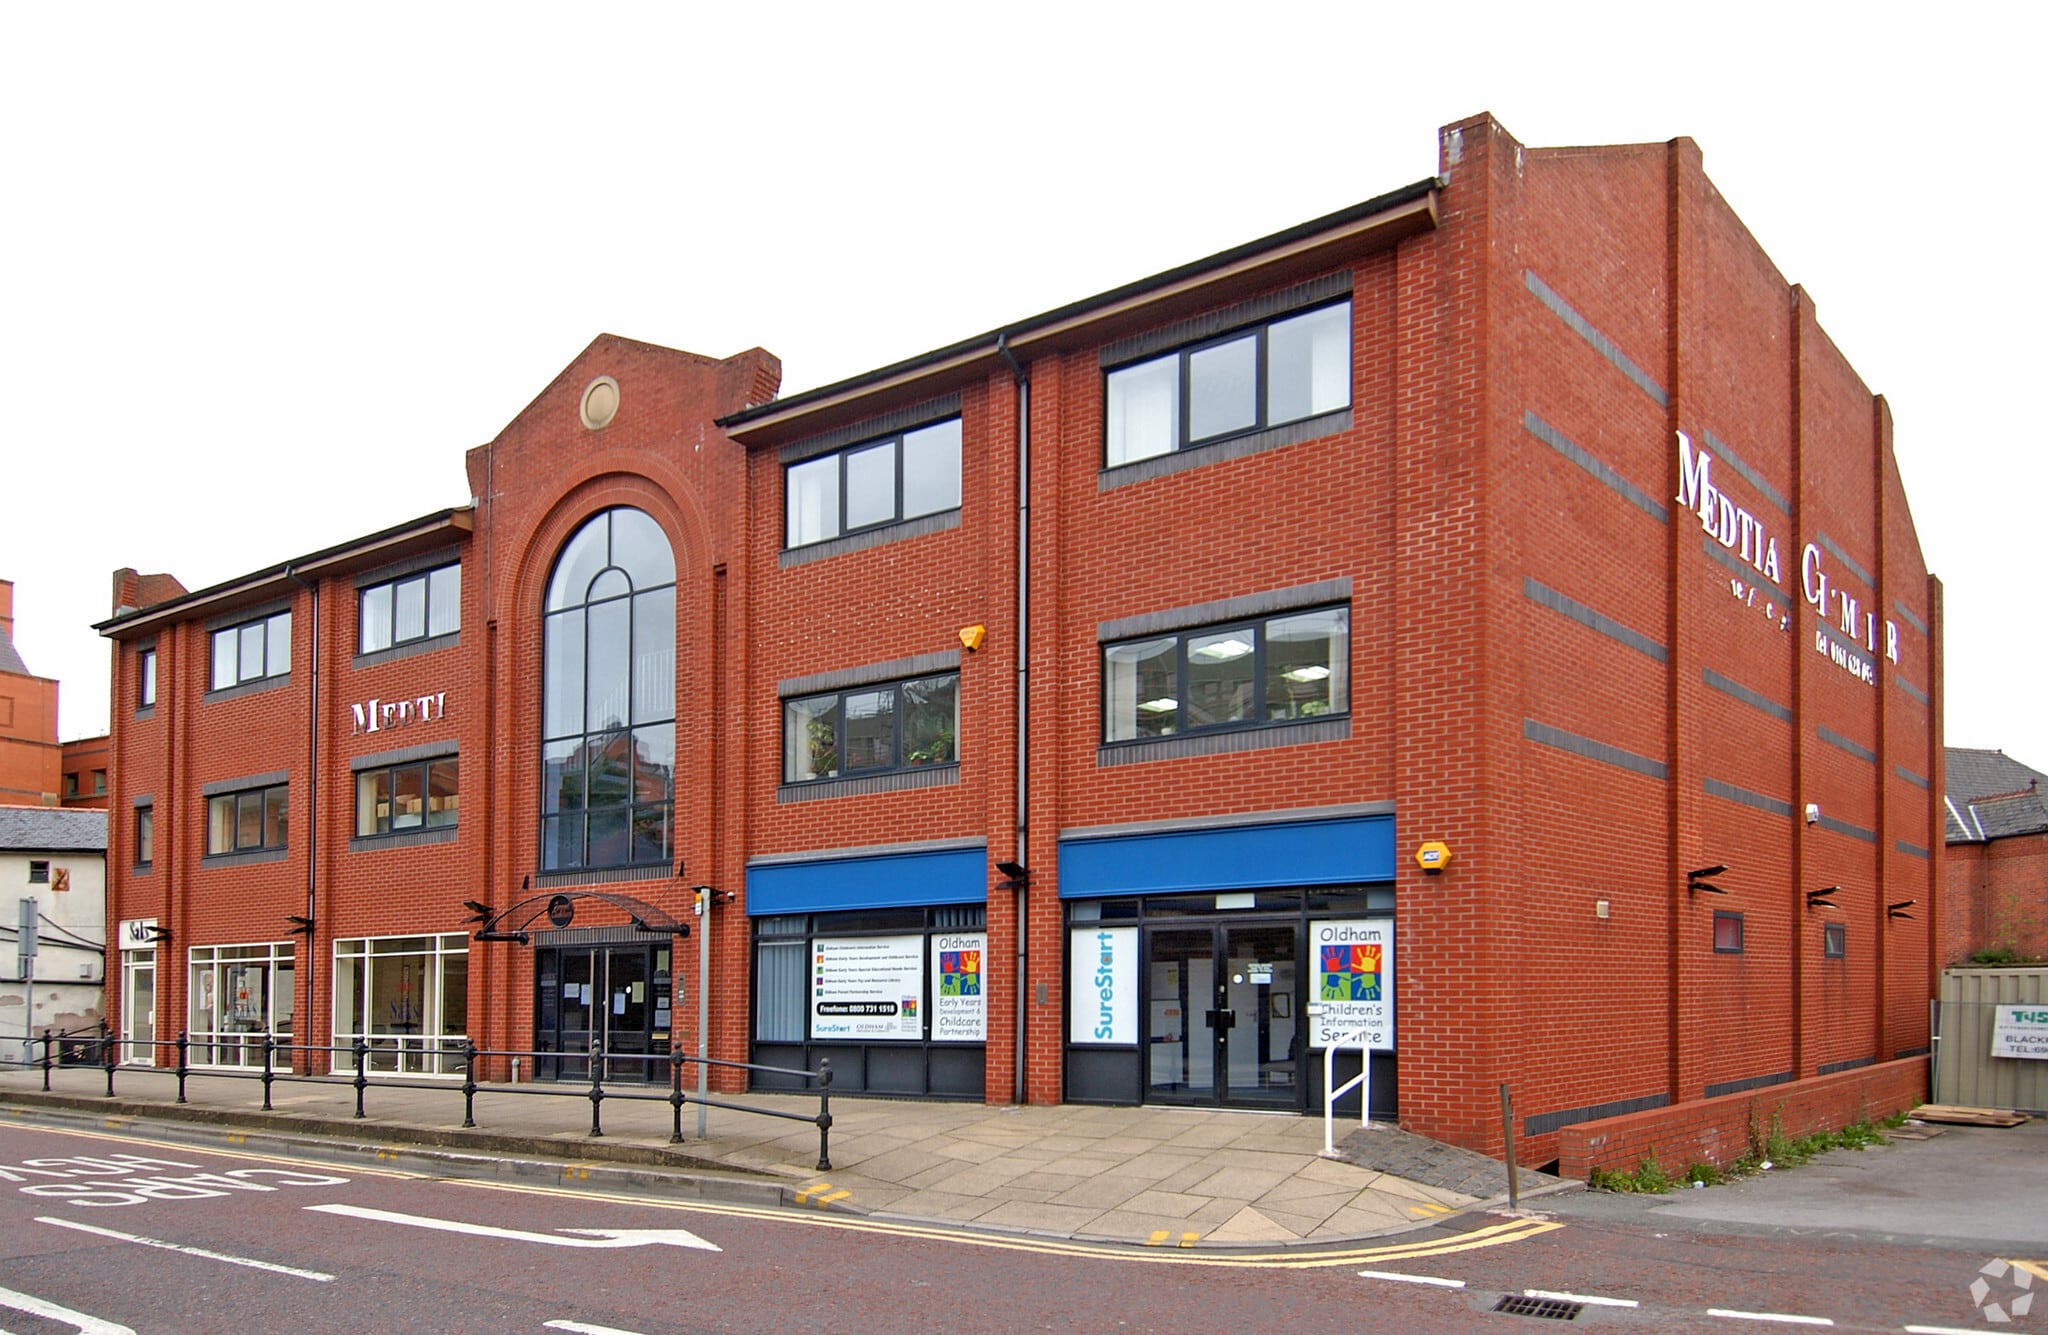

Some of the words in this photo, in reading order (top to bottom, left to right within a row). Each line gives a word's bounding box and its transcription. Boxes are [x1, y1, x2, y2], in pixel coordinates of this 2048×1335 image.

[1675, 430, 1781, 584] MEDTIA
[351, 692, 446, 736] MEDTI
[1320, 927, 1382, 941] Oldham
[939, 937, 980, 949] Oldham
[1094, 932, 1113, 1039] SureStart
[940, 998, 958, 1008] Early
[960, 999, 981, 1007] Years
[866, 1005, 877, 1013] 731
[940, 1008, 975, 1016] Development
[1321, 1003, 1383, 1015] Children's
[940, 1016, 981, 1026] Childcare
[1320, 1017, 1383, 1027] Information
[816, 1024, 850, 1033] SureStart
[940, 1027, 980, 1037] Partnership
